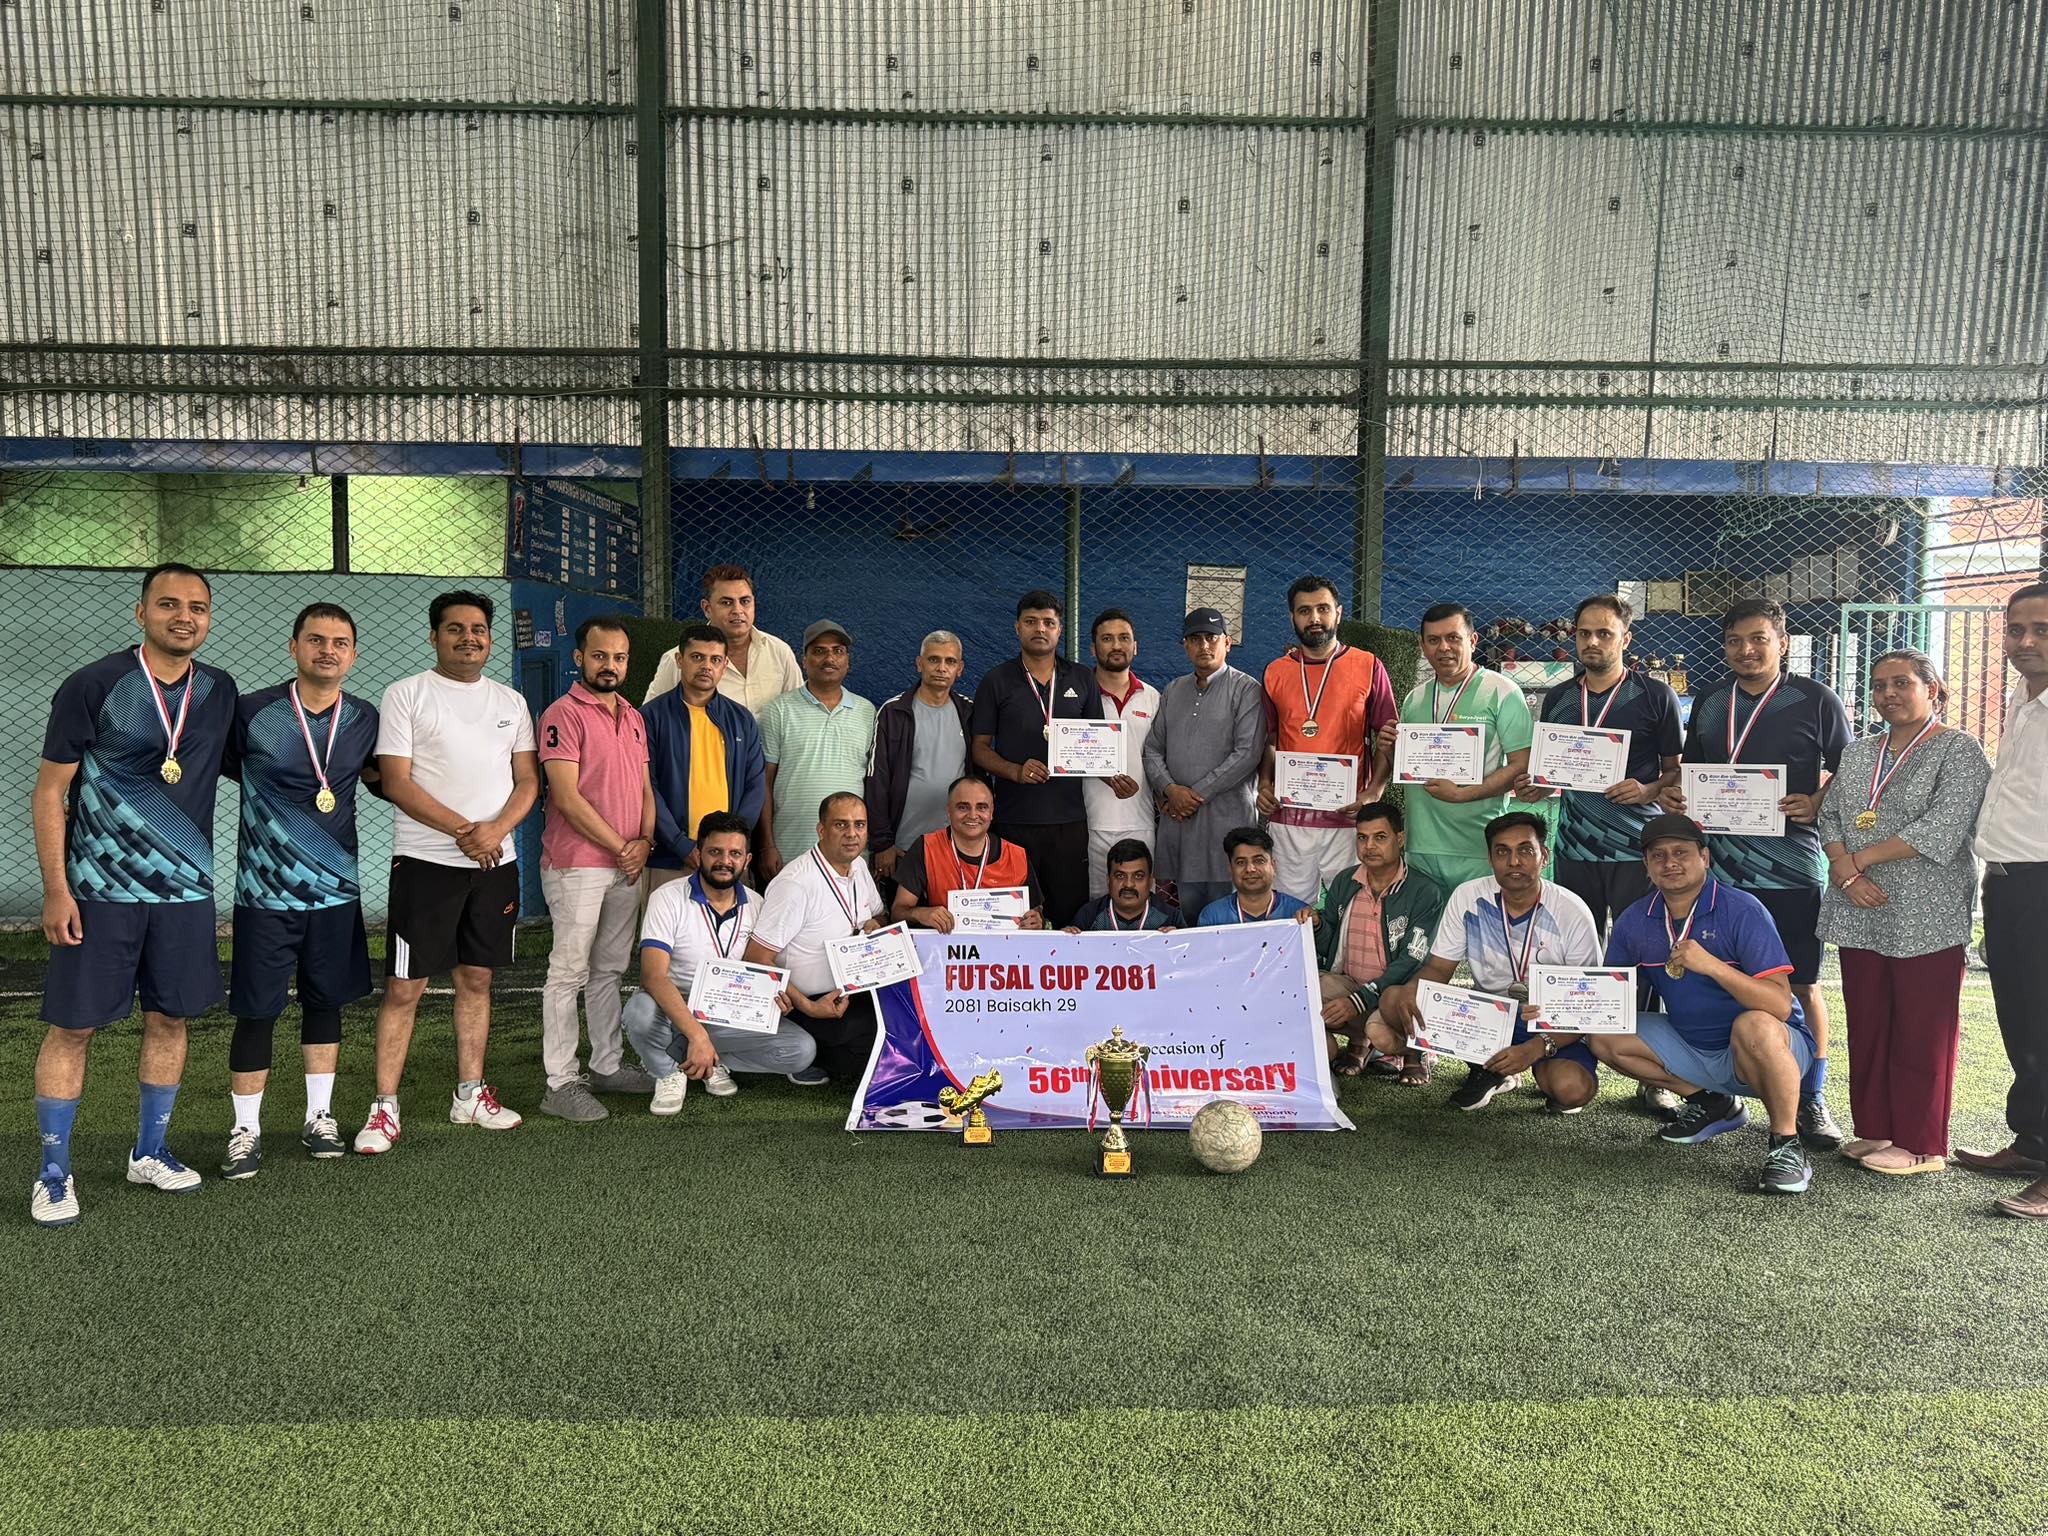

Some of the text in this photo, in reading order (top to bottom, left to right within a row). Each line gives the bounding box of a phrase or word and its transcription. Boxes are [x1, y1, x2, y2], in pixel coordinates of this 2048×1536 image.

[547, 725, 558, 748] 3
[947, 944, 980, 960] NIA
[945, 963, 1157, 992] FUTSAL CUP 2081
[945, 998, 1077, 1013] 2081 Baisakh 29
[1210, 1039, 1227, 1060] of
[1142, 1062, 1297, 1093] niversary
